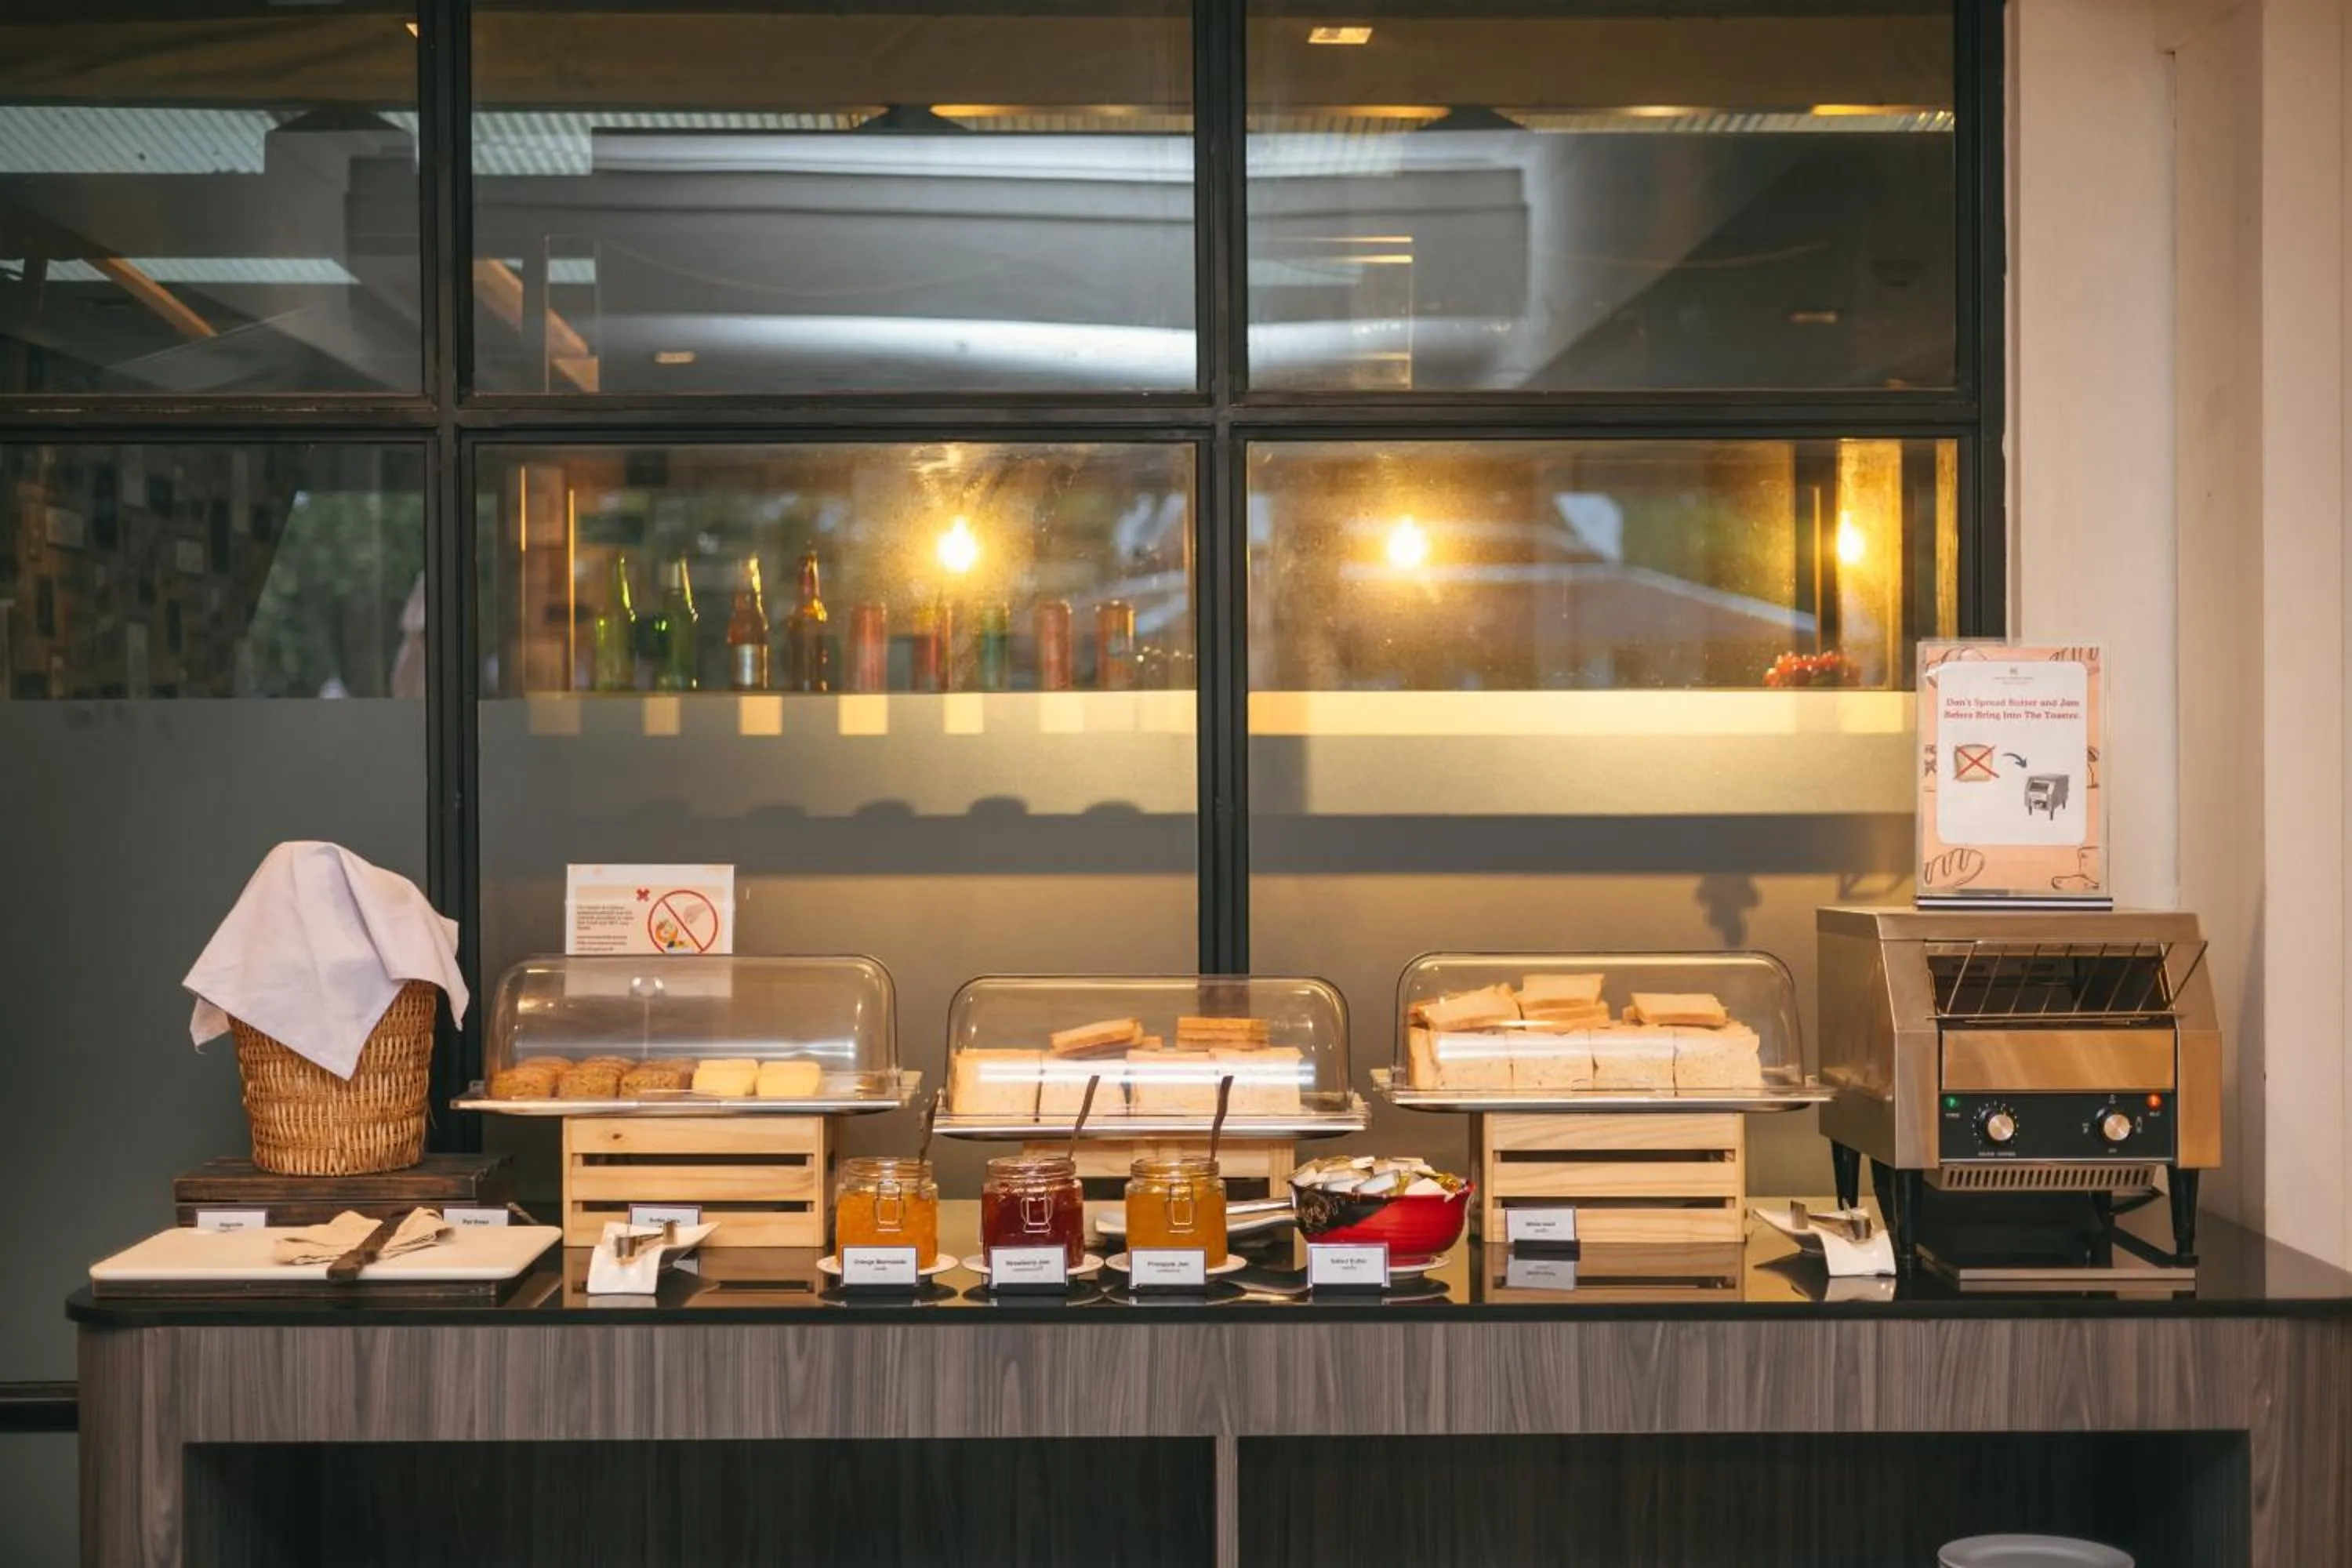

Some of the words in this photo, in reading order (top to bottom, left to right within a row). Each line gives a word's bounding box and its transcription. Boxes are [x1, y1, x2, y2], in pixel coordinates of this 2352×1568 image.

[1946, 698, 1972, 706] Don't
[1974, 698, 2006, 707] Spread
[2008, 698, 2038, 706] Butter
[2060, 698, 2080, 707] Jam
[1944, 710, 1973, 719] Before
[1975, 710, 2001, 720] Bring
[2002, 710, 2022, 719] Into
[2024, 710, 2042, 719] The
